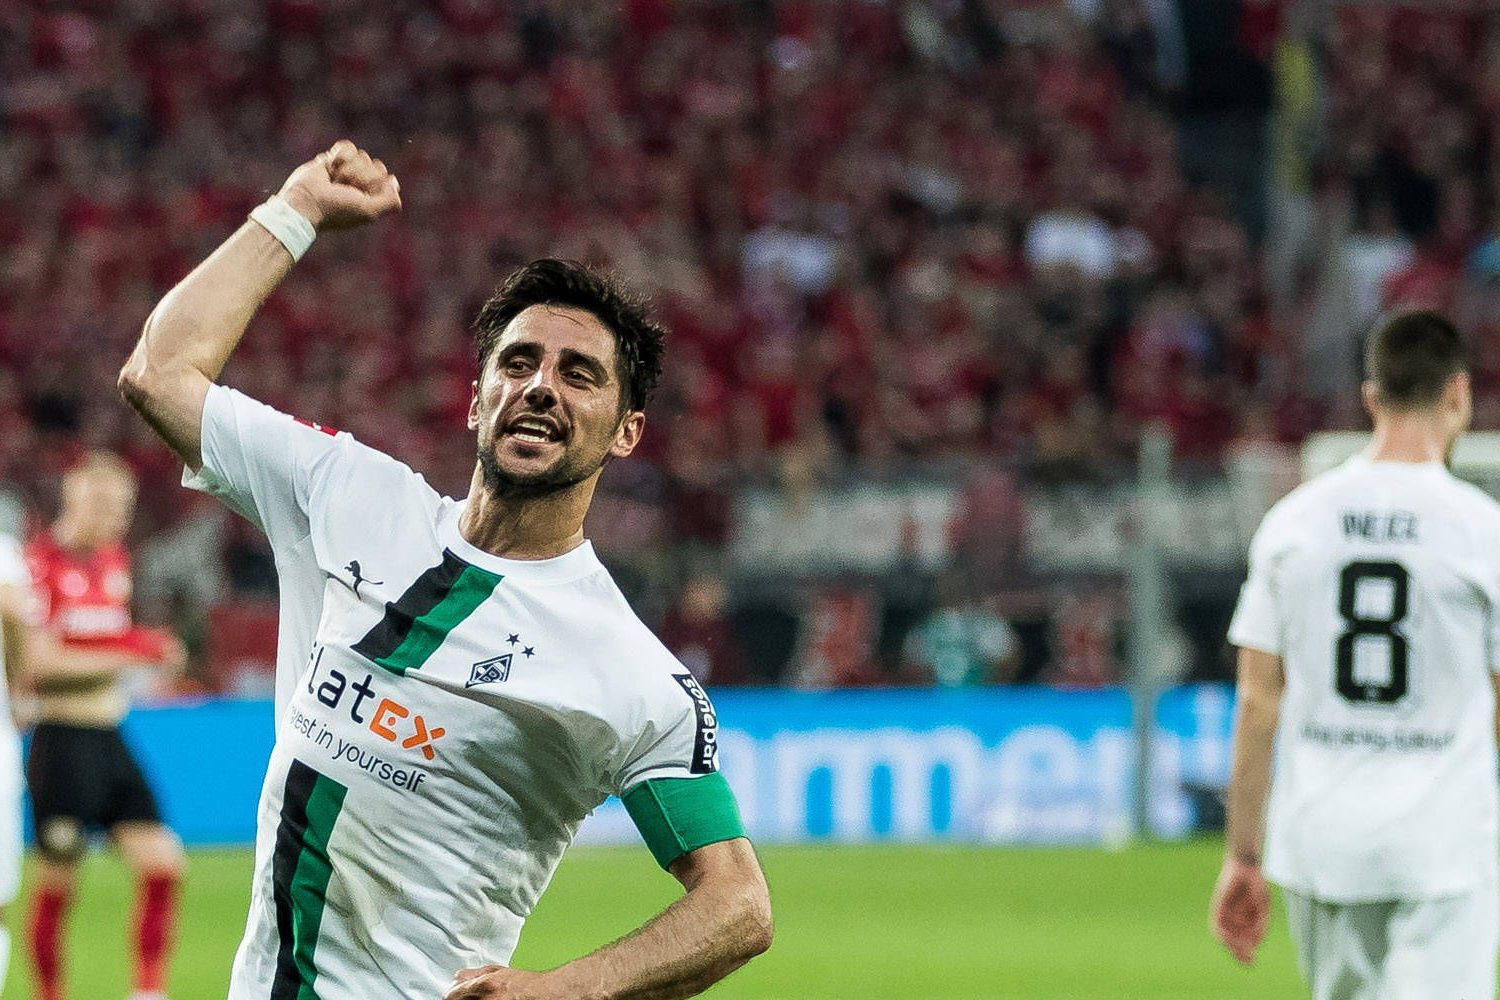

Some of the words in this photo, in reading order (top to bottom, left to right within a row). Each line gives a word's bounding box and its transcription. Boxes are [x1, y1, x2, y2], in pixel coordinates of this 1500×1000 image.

[1335, 560, 1409, 704] 8
[307, 641, 446, 761] latex
[682, 678, 717, 769] sonepar
[314, 723, 334, 749] in
[331, 738, 426, 793] yourself
